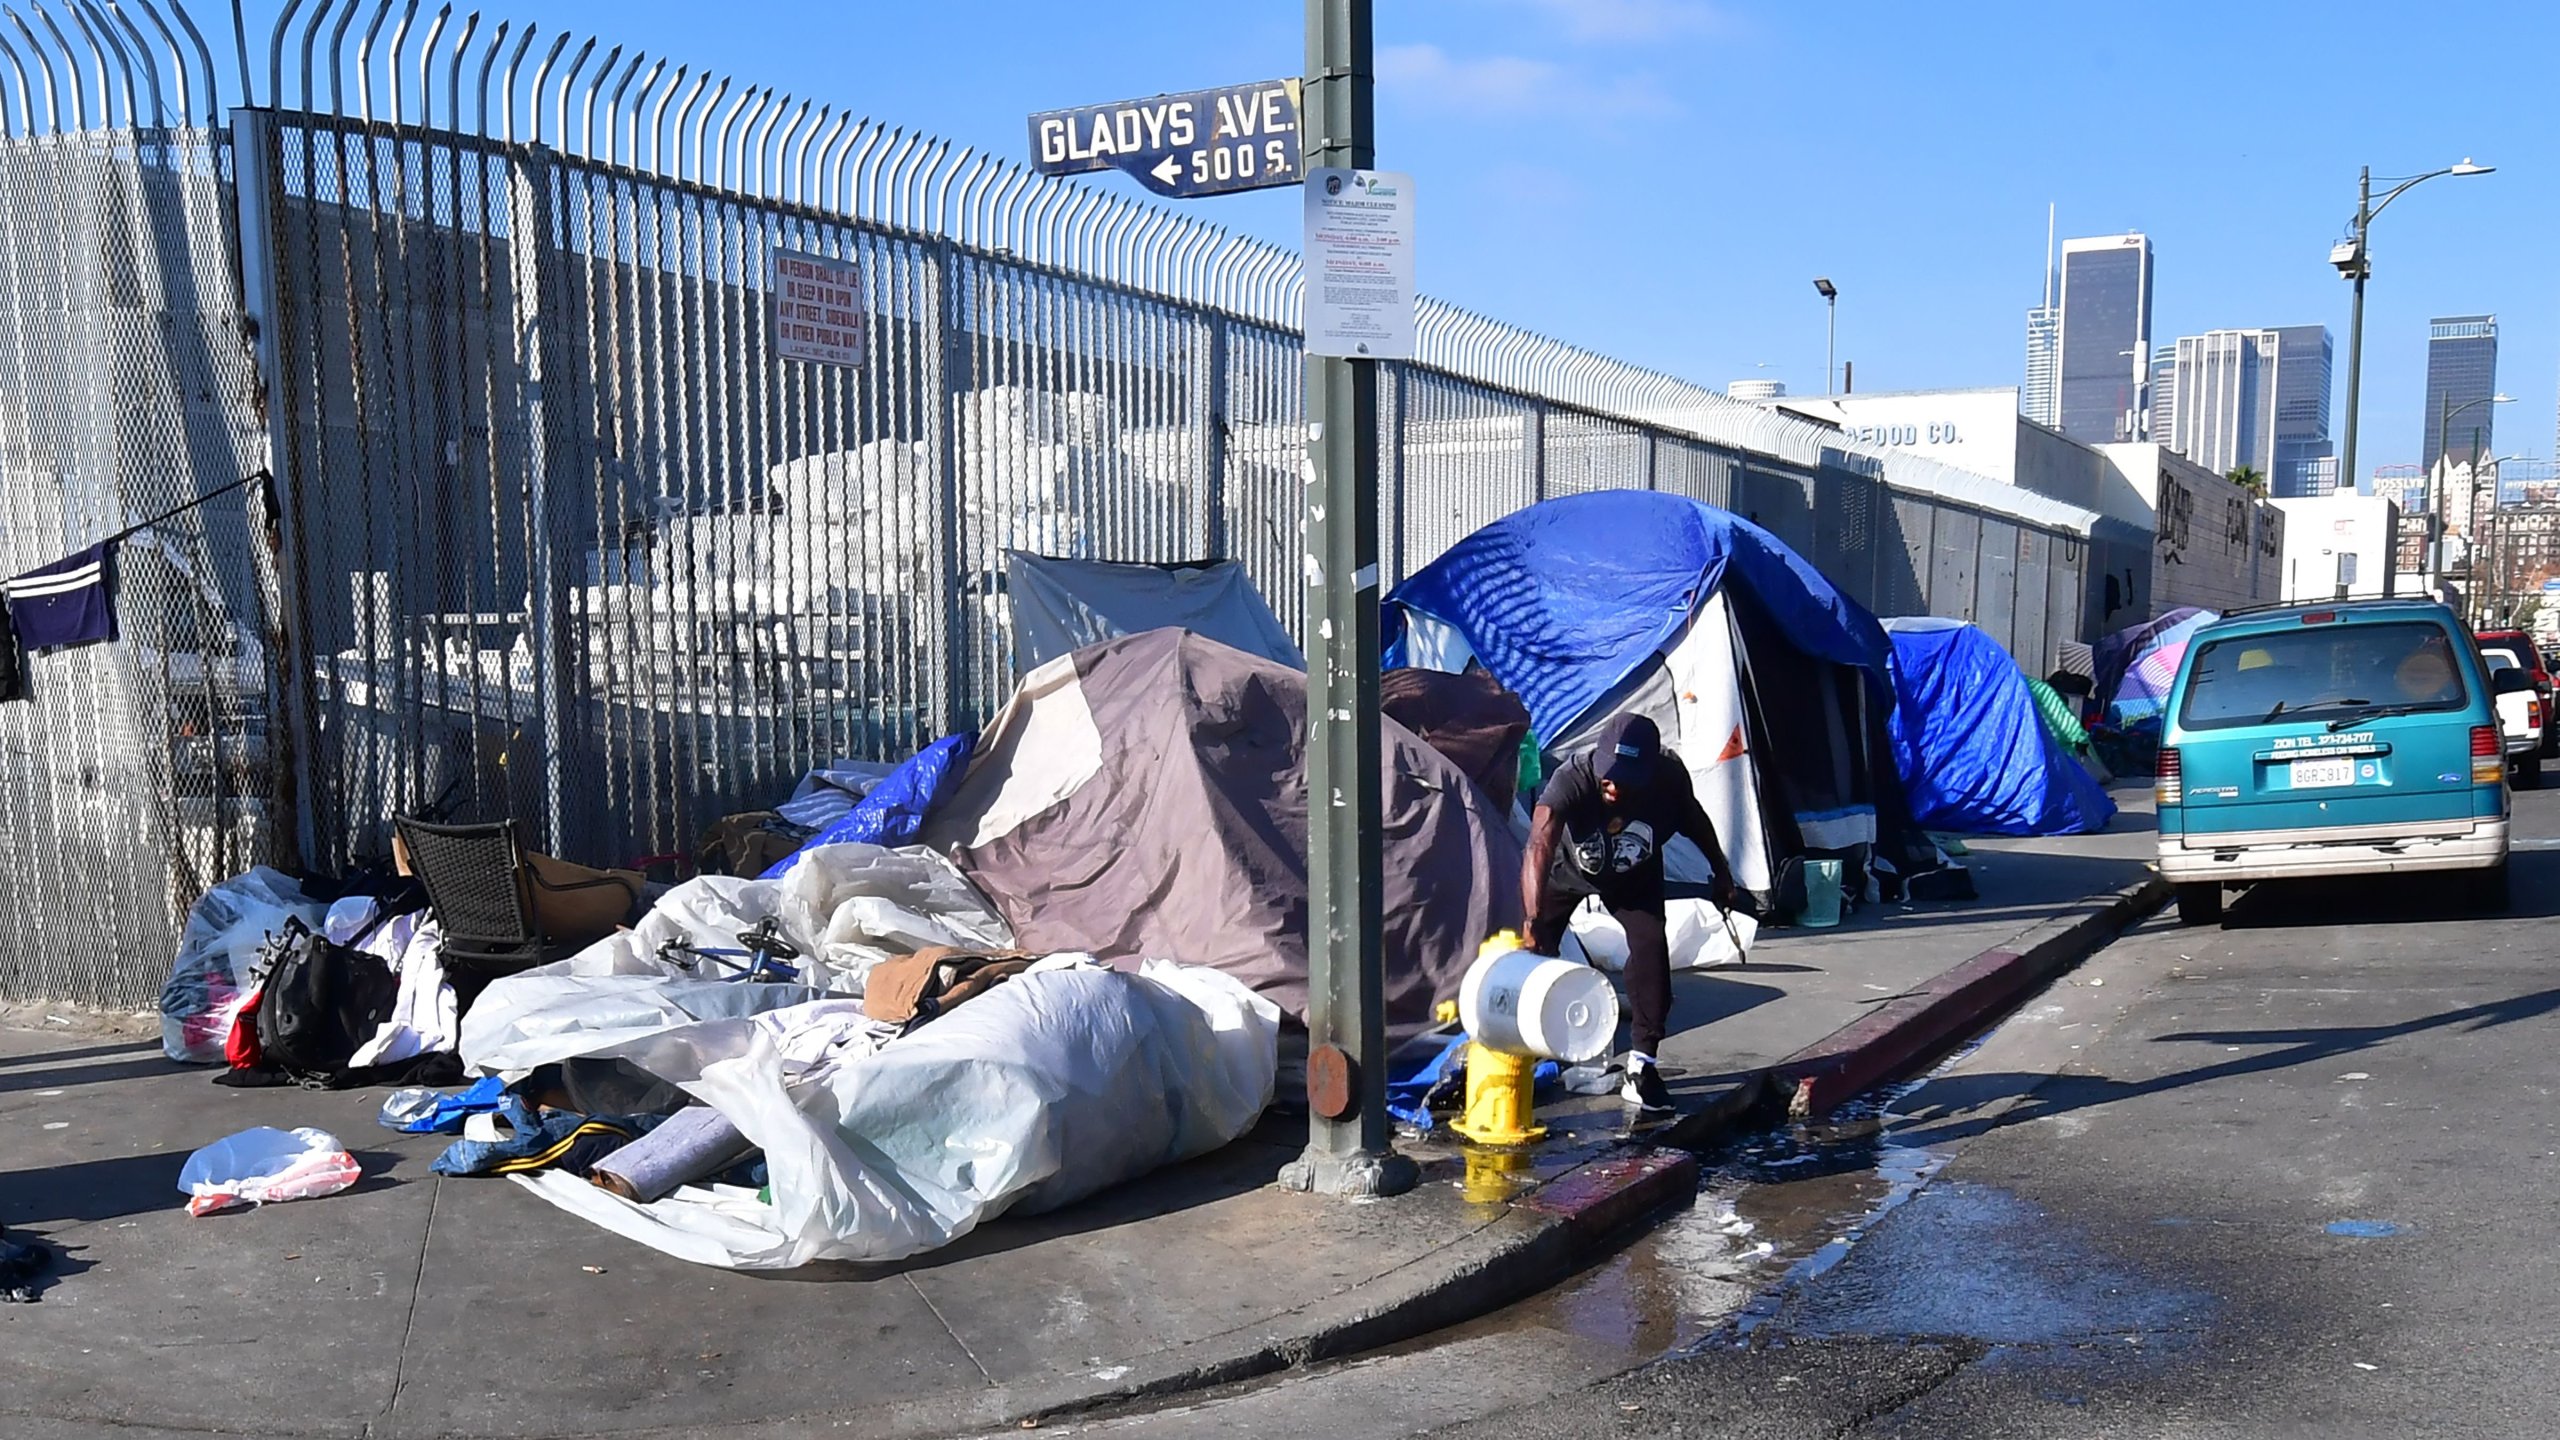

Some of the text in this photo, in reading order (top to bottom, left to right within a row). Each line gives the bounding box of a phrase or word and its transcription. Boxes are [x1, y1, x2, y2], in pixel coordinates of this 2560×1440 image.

[1040, 88, 1295, 163] GLADYS AVE.
[1191, 139, 1293, 184] 500 S.
[790, 260, 814, 280] PERSON
[815, 264, 834, 284] SHALL
[848, 272, 858, 288] LIE
[797, 282, 816, 300] SLEEP
[779, 300, 794, 317] ANY
[826, 308, 859, 329] SIDEWALK
[792, 323, 815, 343] OTHER
[816, 328, 840, 347] PUBLIC
[1926, 421, 1964, 445] CO.
[2372, 477, 2425, 490] ROSSLYN
